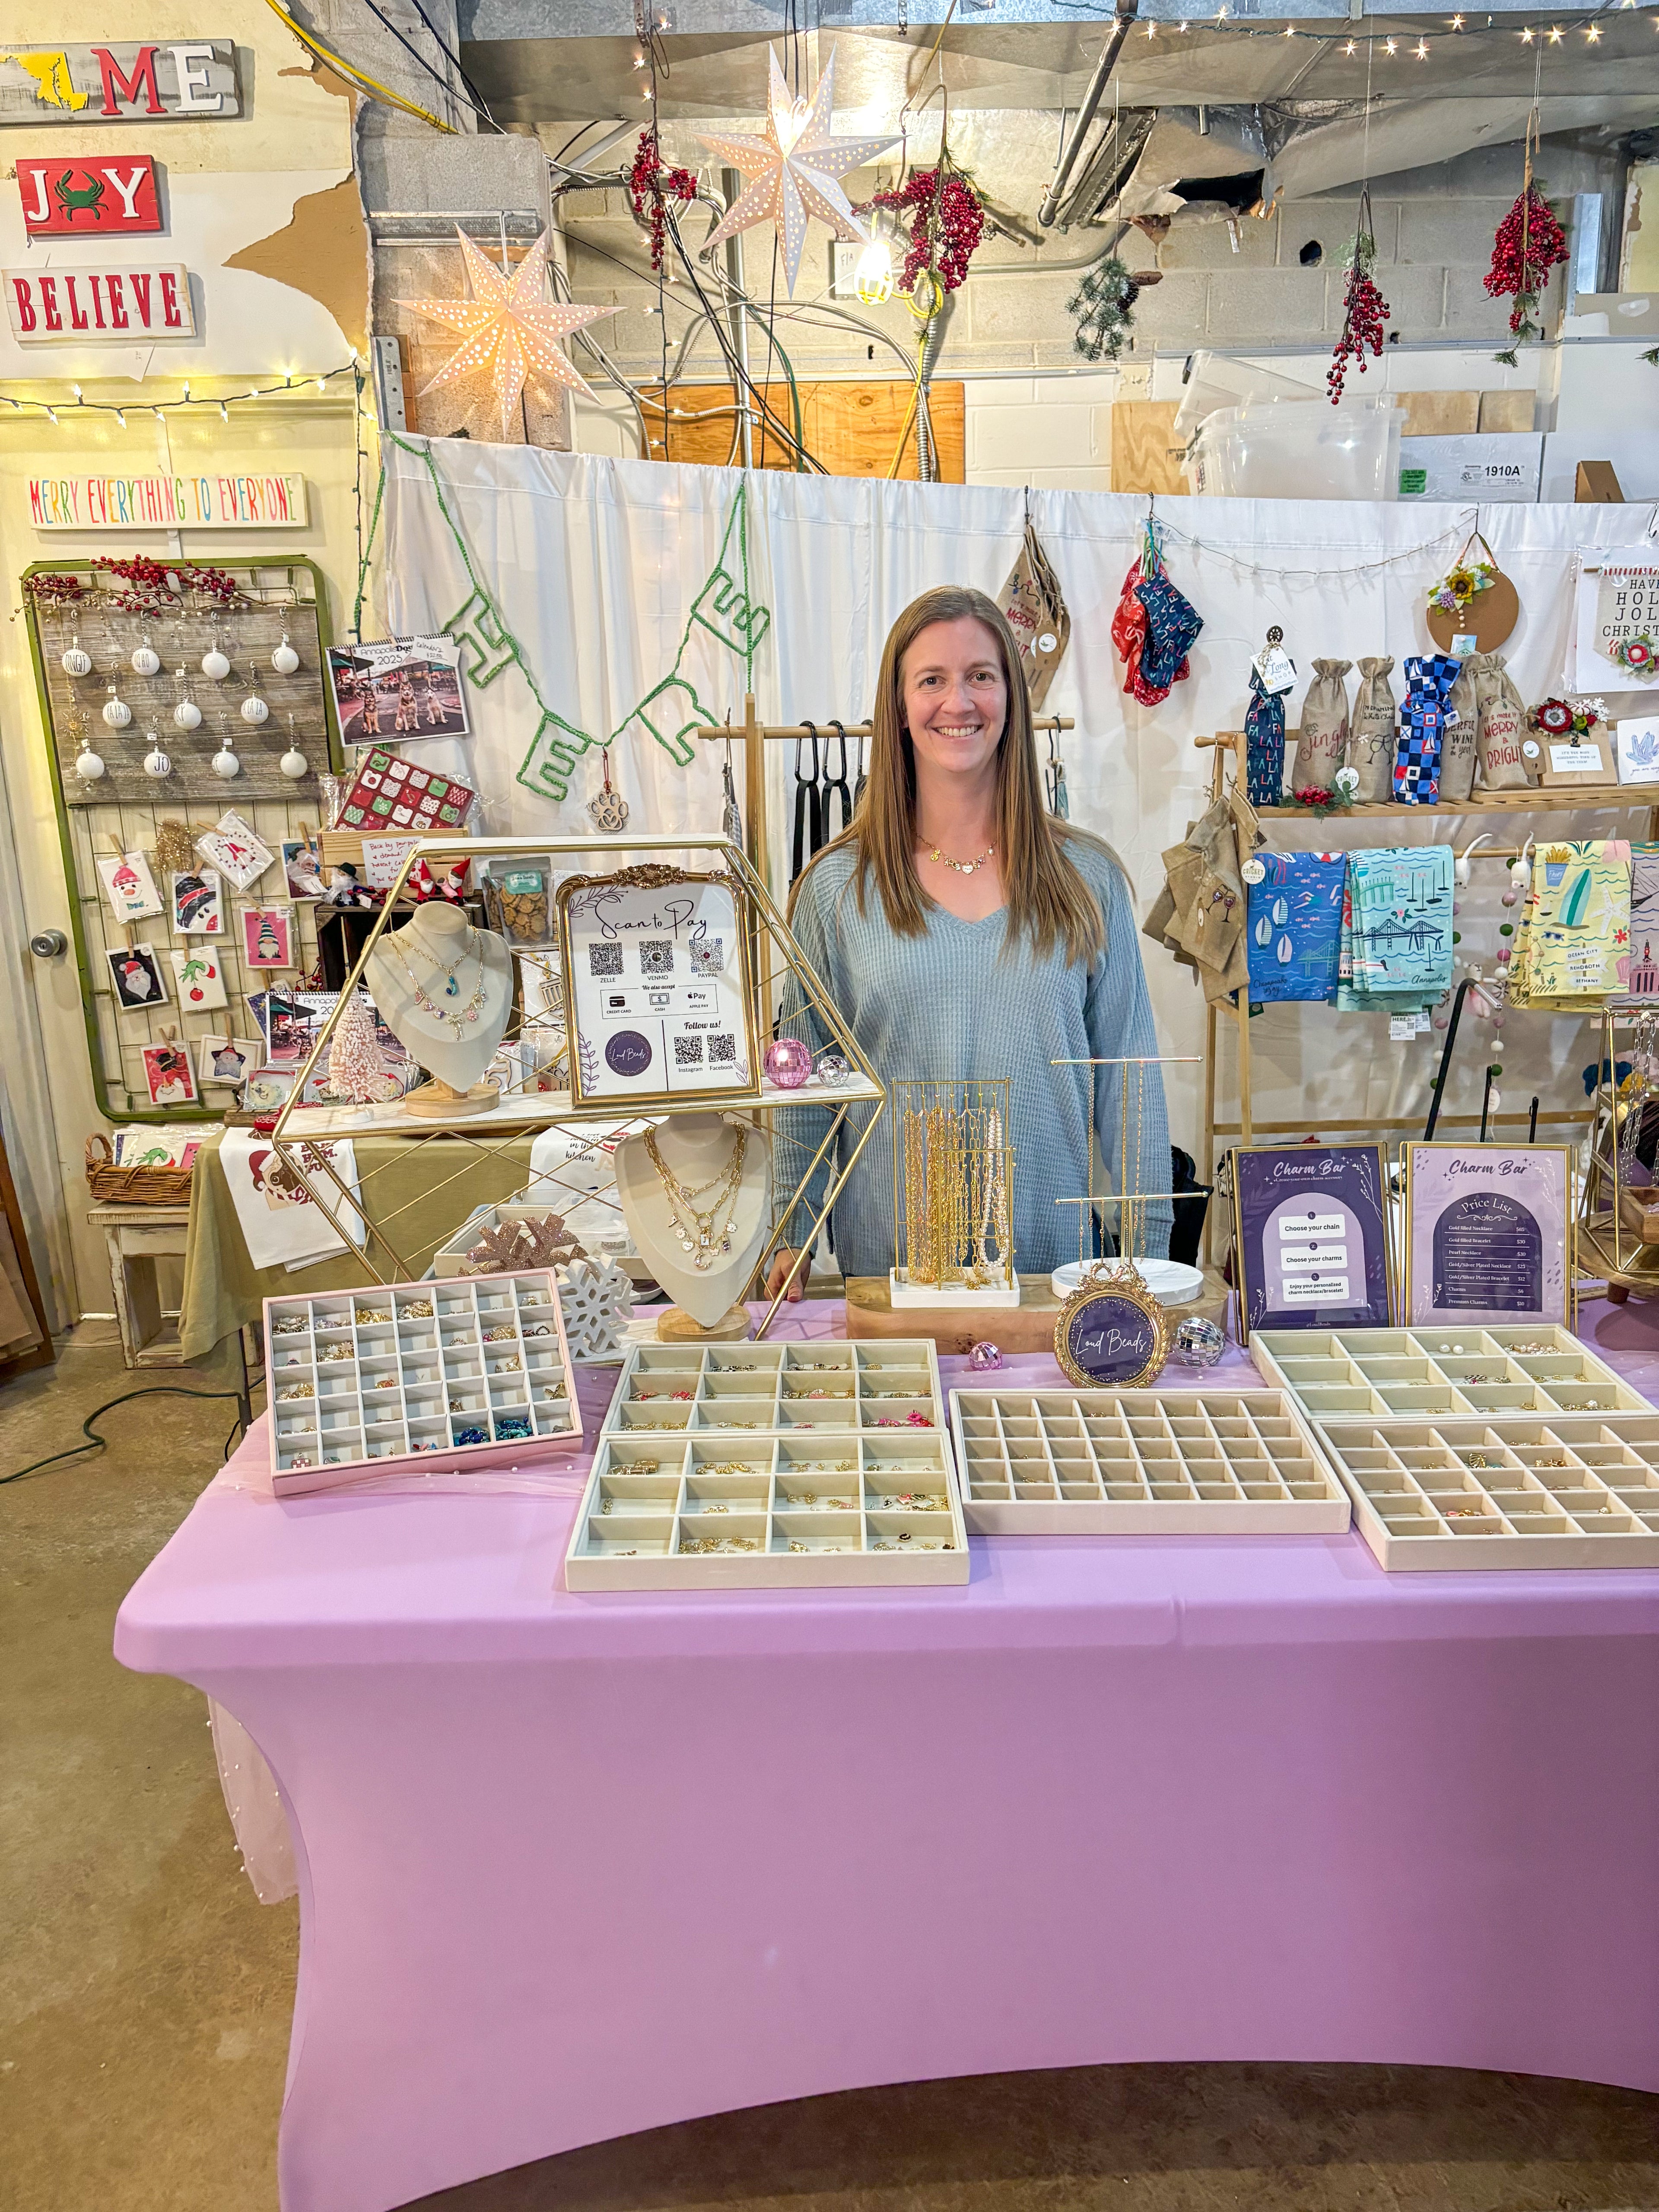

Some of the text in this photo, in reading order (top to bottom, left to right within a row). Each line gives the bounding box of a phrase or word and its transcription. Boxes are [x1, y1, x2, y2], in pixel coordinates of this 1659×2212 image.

[27, 167, 149, 222] JY
[13, 273, 181, 331] BELIEVE
[1484, 466, 1520, 476] 1910A
[30, 477, 297, 524] MERRY EVERYTHING TO EVERYONE
[65, 654, 86, 672] INGLE
[377, 655, 402, 665] 2025
[385, 842, 393, 852] by
[595, 894, 706, 940] Scan to Pay
[1411, 973, 1448, 984] Annapolis
[684, 1021, 708, 1030] Follow
[626, 1048, 646, 1062] Beads
[1273, 1159, 1346, 1177] Charm Bar
[1449, 1160, 1528, 1176] Charm Bar
[1461, 1198, 1512, 1214] Price List
[1075, 1328, 1147, 1356] Loud Beads
